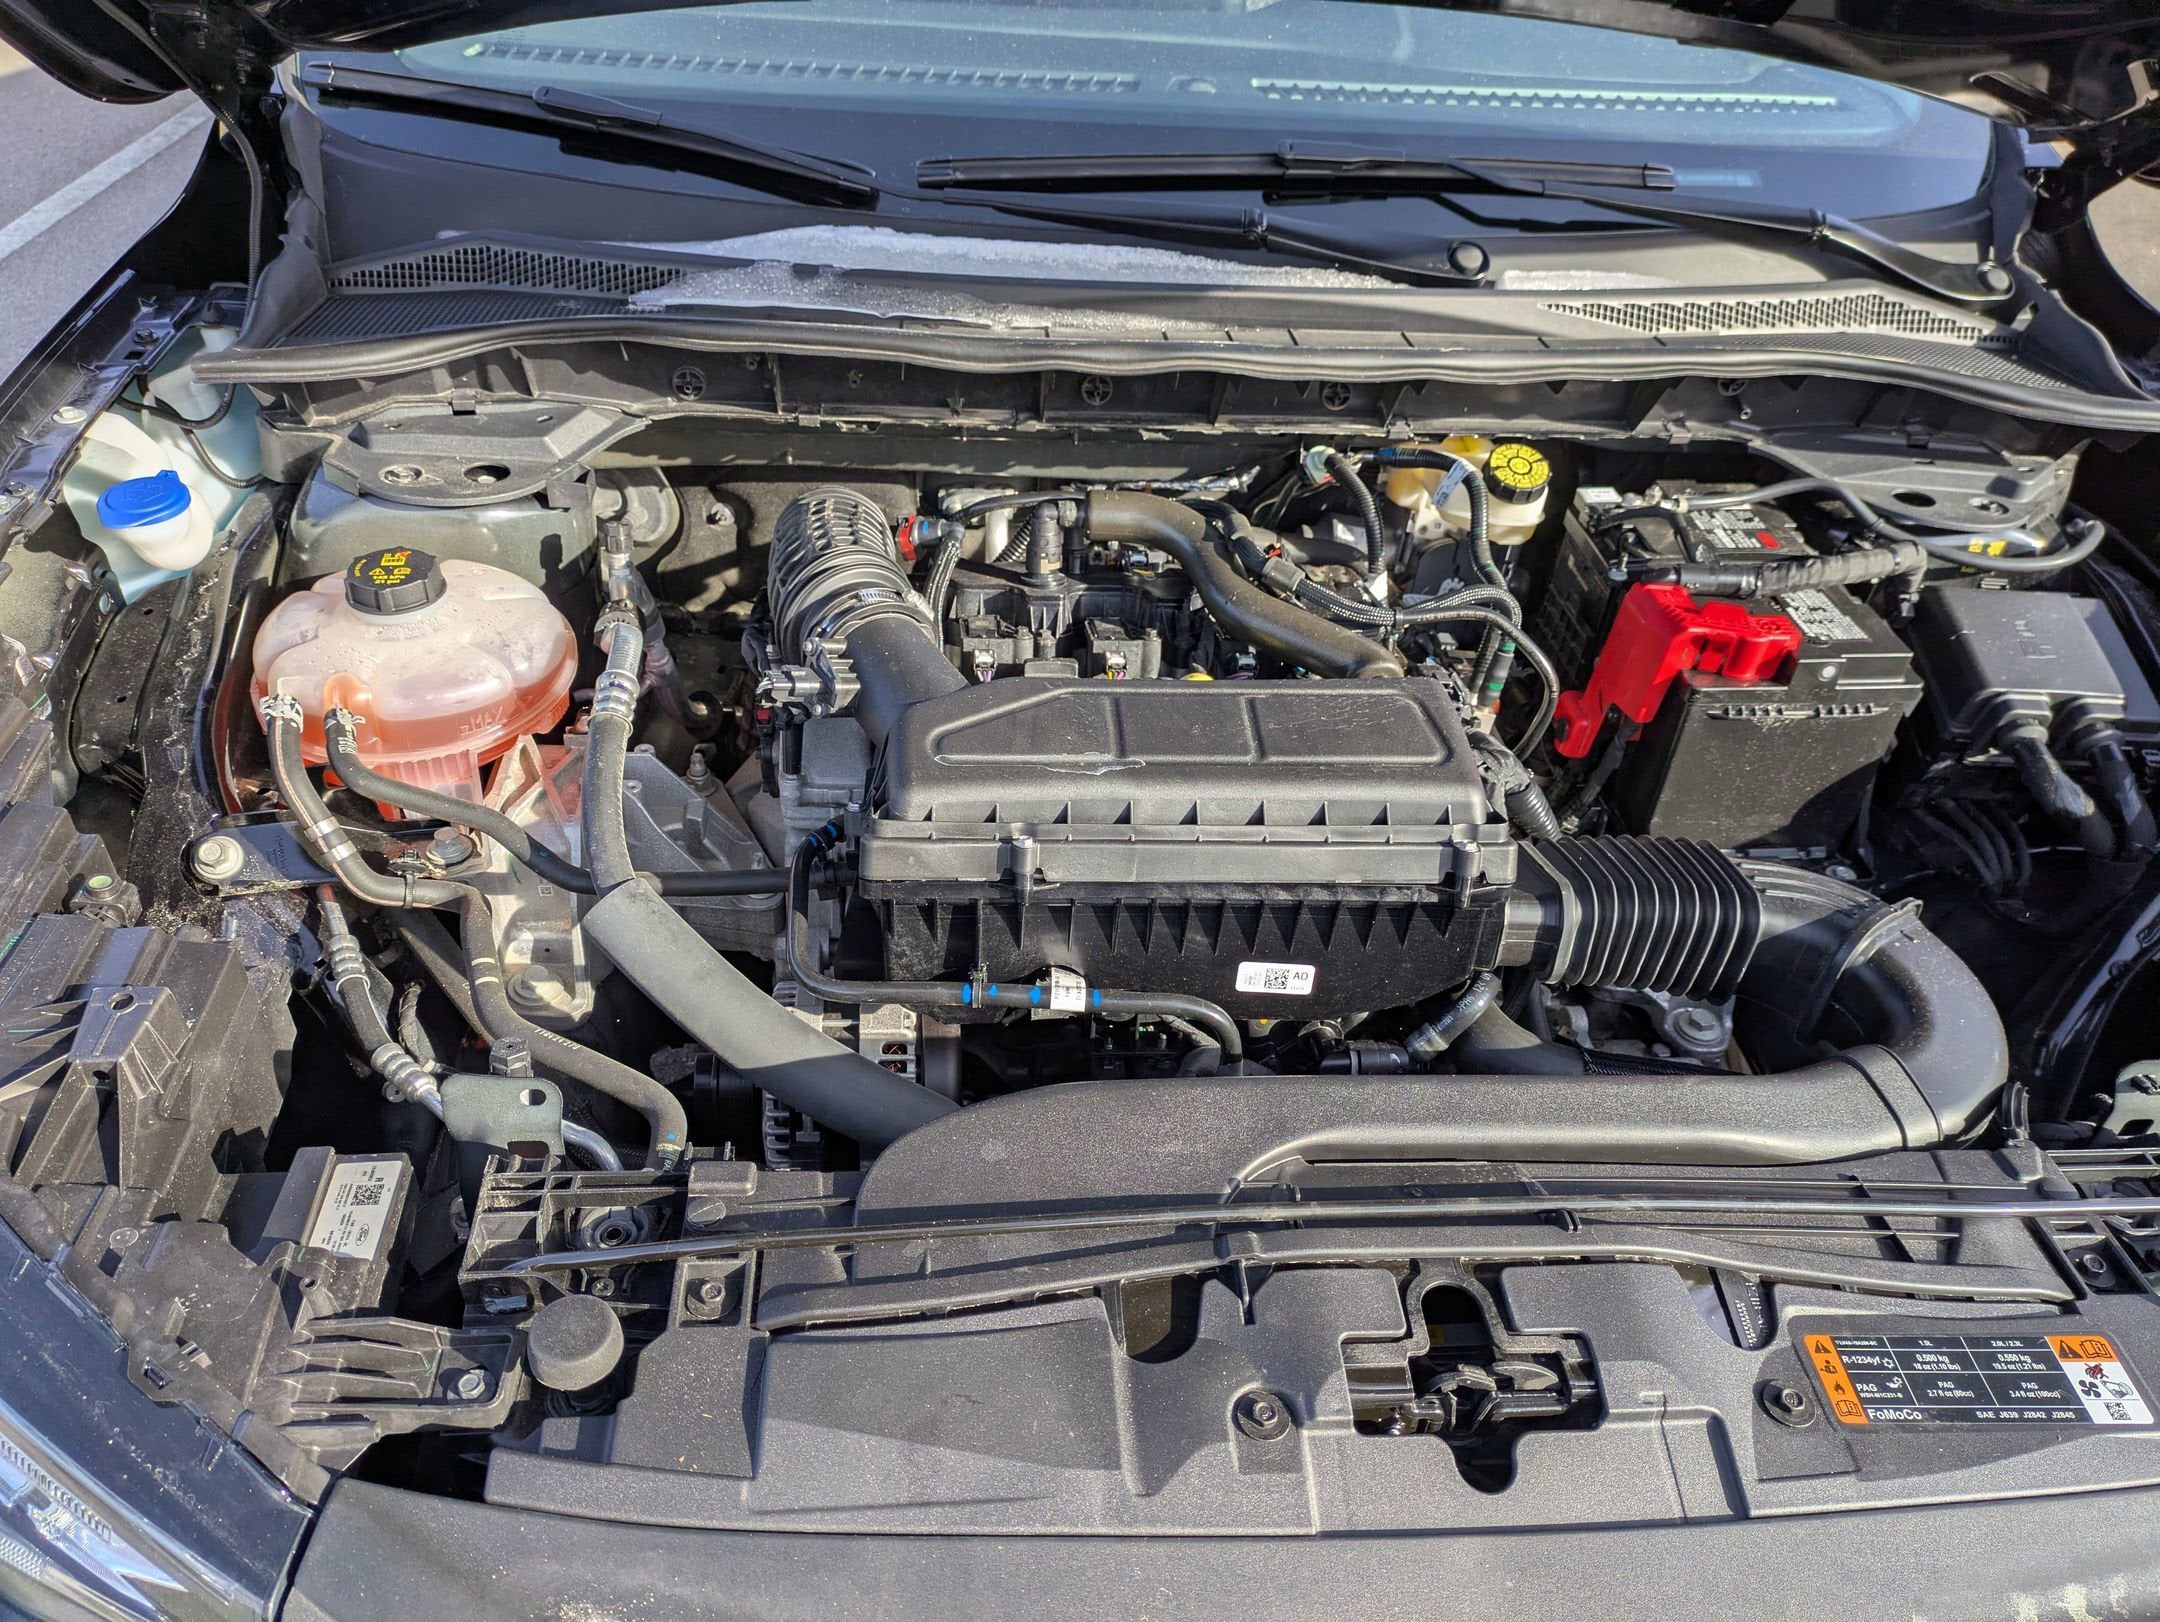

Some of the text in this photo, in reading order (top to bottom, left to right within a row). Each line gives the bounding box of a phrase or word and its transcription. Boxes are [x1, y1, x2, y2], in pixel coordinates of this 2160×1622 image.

[1292, 971, 1309, 981] AD
[1841, 1355, 1881, 1366] R-1234yf
[1916, 1354, 1950, 1363] 0.500 kg
[1998, 1354, 2032, 1363] 0.550 kg
[1856, 1383, 1878, 1392] PAG
[1867, 1408, 2076, 1420] FoMoCo SAE J639 J2842 J2845
